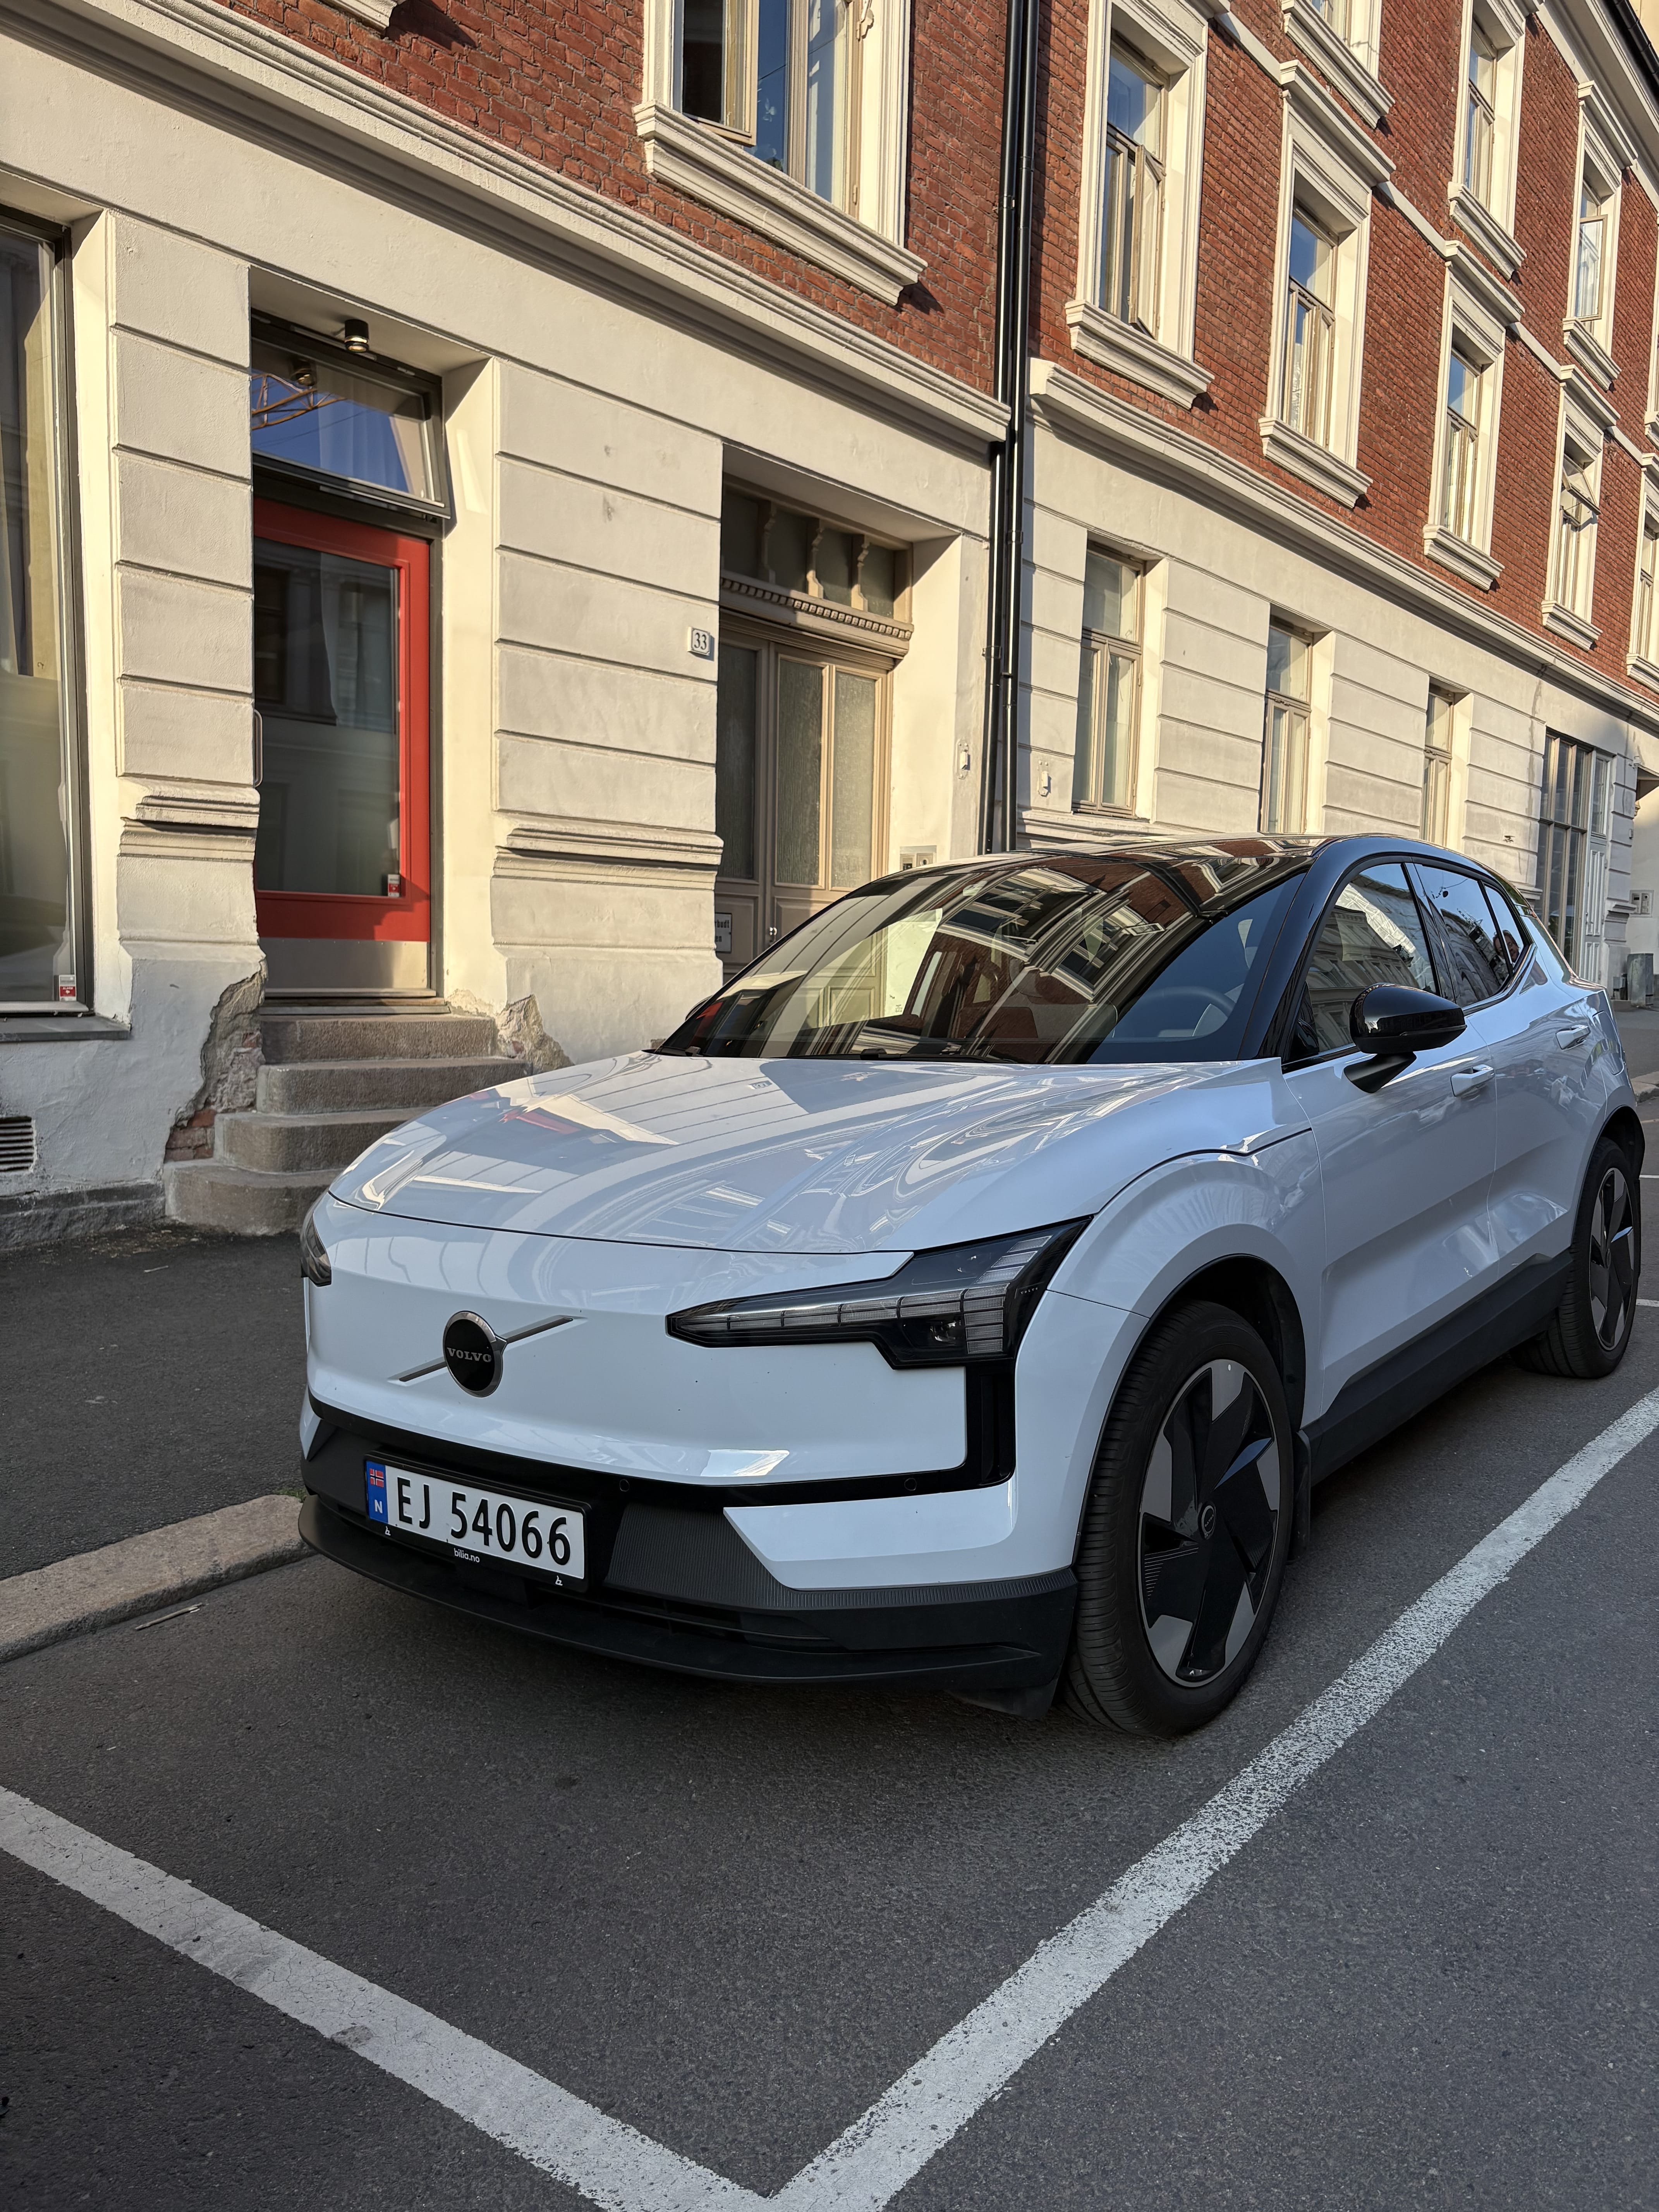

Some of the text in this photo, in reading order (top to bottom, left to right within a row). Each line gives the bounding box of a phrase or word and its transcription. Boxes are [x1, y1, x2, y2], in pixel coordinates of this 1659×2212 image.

[694, 632, 707, 650] 33
[447, 1347, 492, 1363] VOLVO
[374, 1499, 383, 1514] N
[397, 1477, 570, 1565] EJ 54066
[454, 1548, 480, 1563] bilia.no
